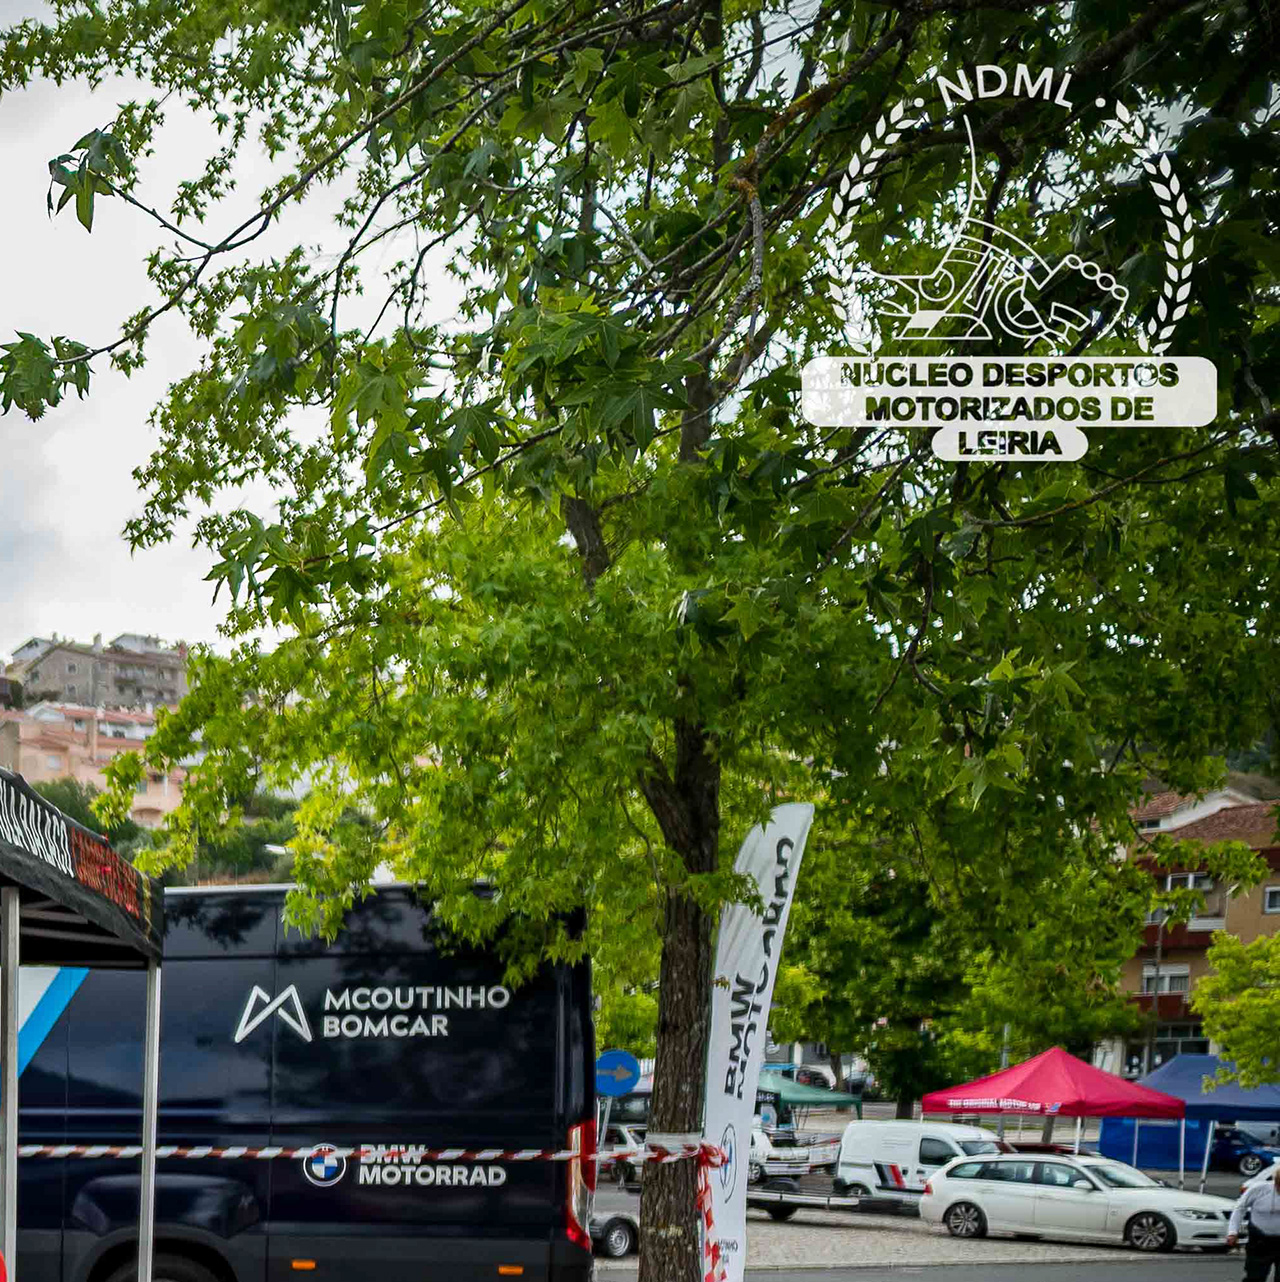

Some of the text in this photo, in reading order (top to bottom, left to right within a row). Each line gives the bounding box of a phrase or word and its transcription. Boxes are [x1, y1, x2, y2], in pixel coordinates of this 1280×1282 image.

[324, 985, 510, 1010] MCOUTINHO
[323, 1014, 448, 1037] BOMCAR
[725, 972, 757, 1094] BMW
[360, 1144, 426, 1164] BMW
[359, 1165, 507, 1186] MOTORRAD
